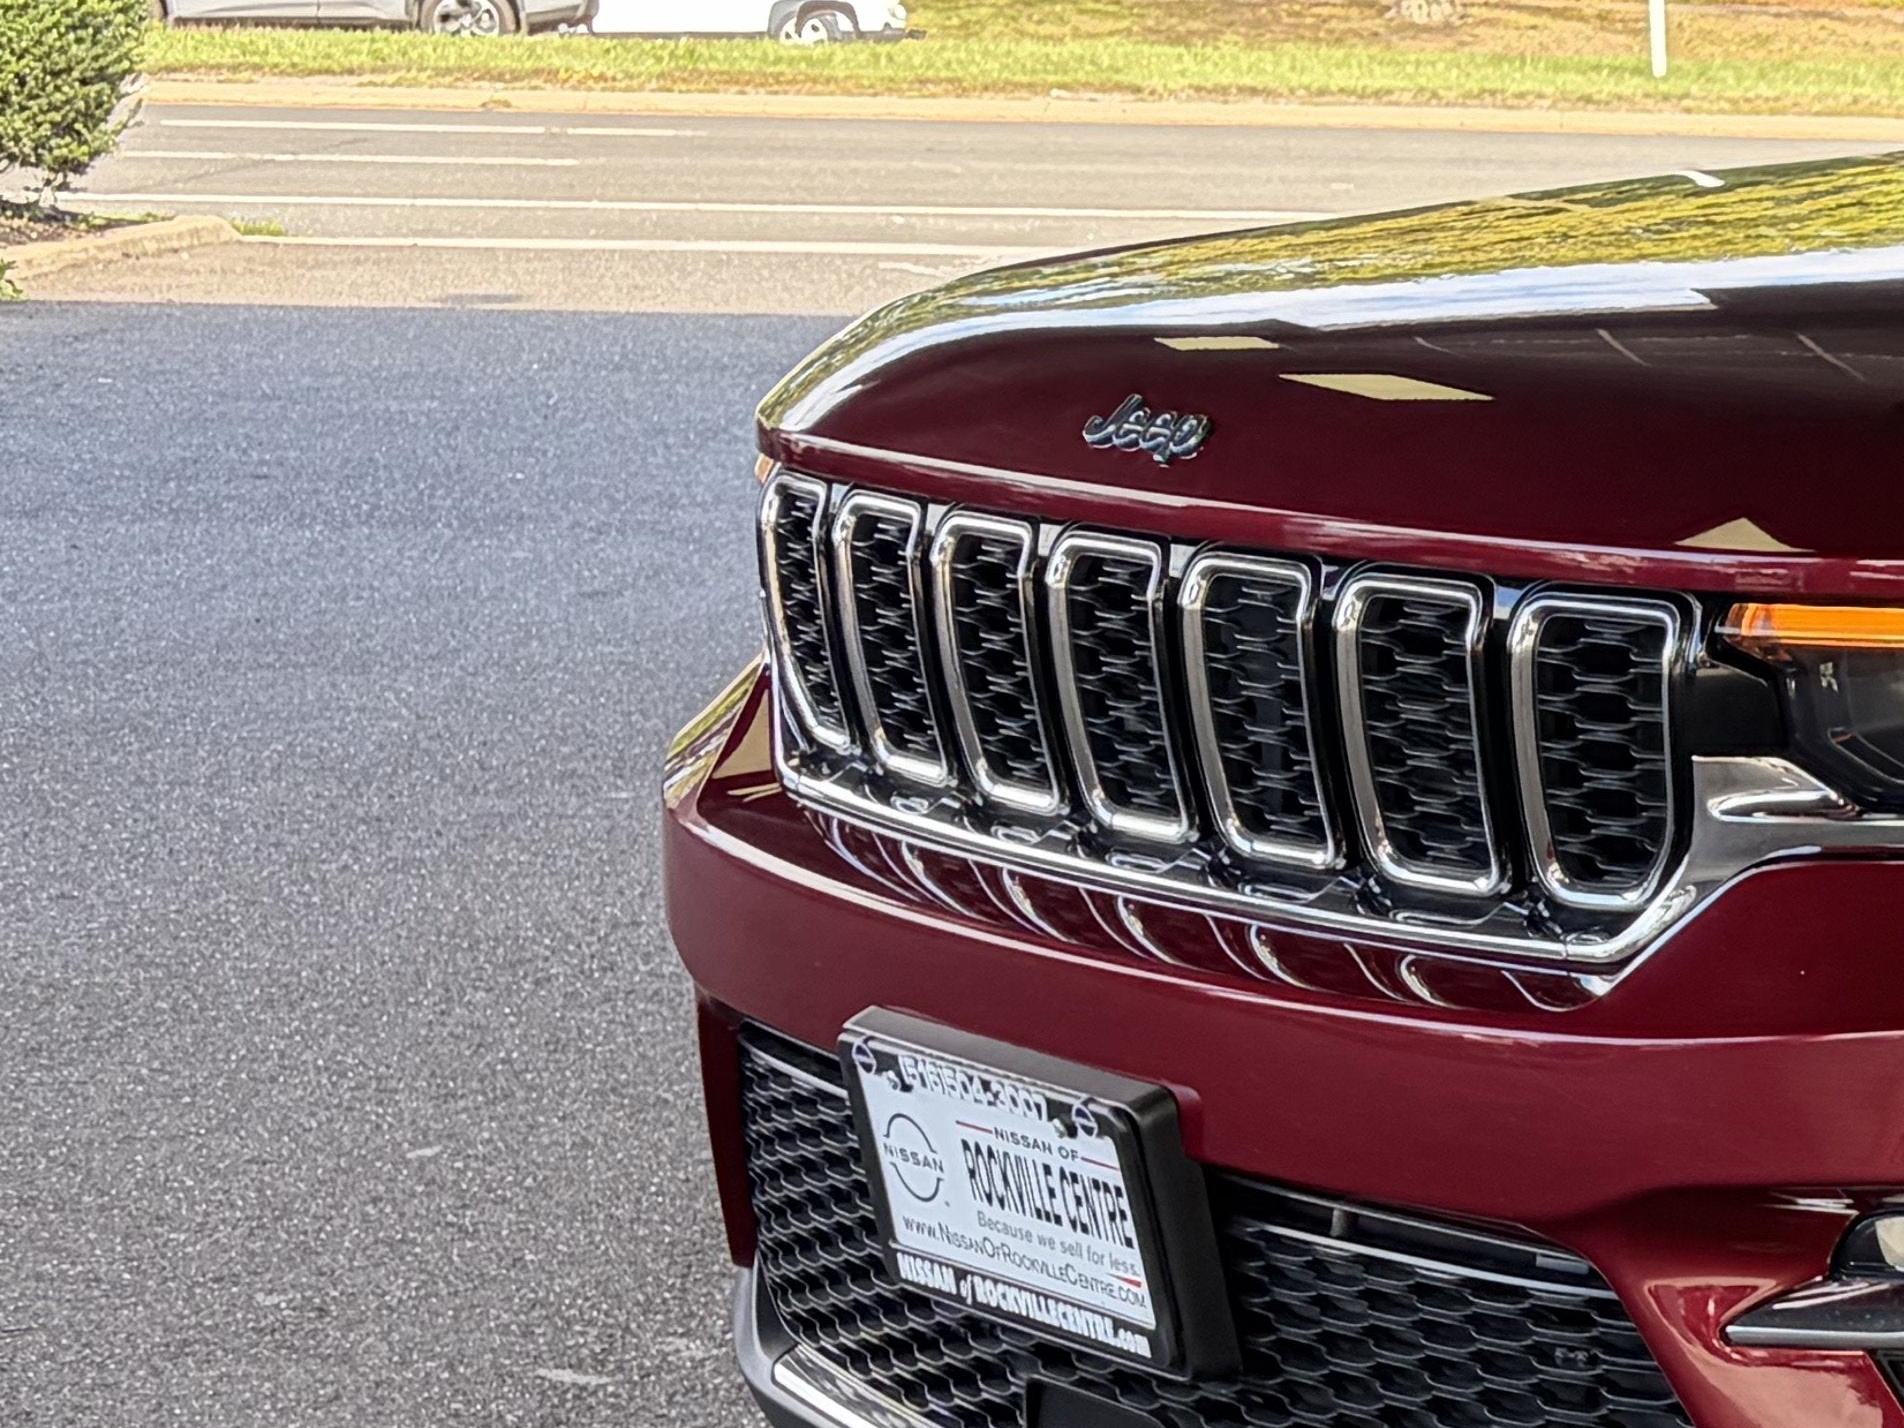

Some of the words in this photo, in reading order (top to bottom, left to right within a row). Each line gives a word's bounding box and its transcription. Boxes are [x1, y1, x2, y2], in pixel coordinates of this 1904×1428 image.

[1083, 394, 1208, 461] Jeep
[883, 1143, 944, 1173] NISSAN
[994, 1127, 1052, 1156] NISSAN
[1058, 1147, 1081, 1163] OF
[961, 1138, 1063, 1227] ROCKVILLE
[1059, 1166, 1134, 1250] CENTRE
[977, 1211, 1033, 1243] Because
[1037, 1233, 1056, 1251] we
[1059, 1238, 1083, 1259] sell
[1086, 1246, 1105, 1266] for
